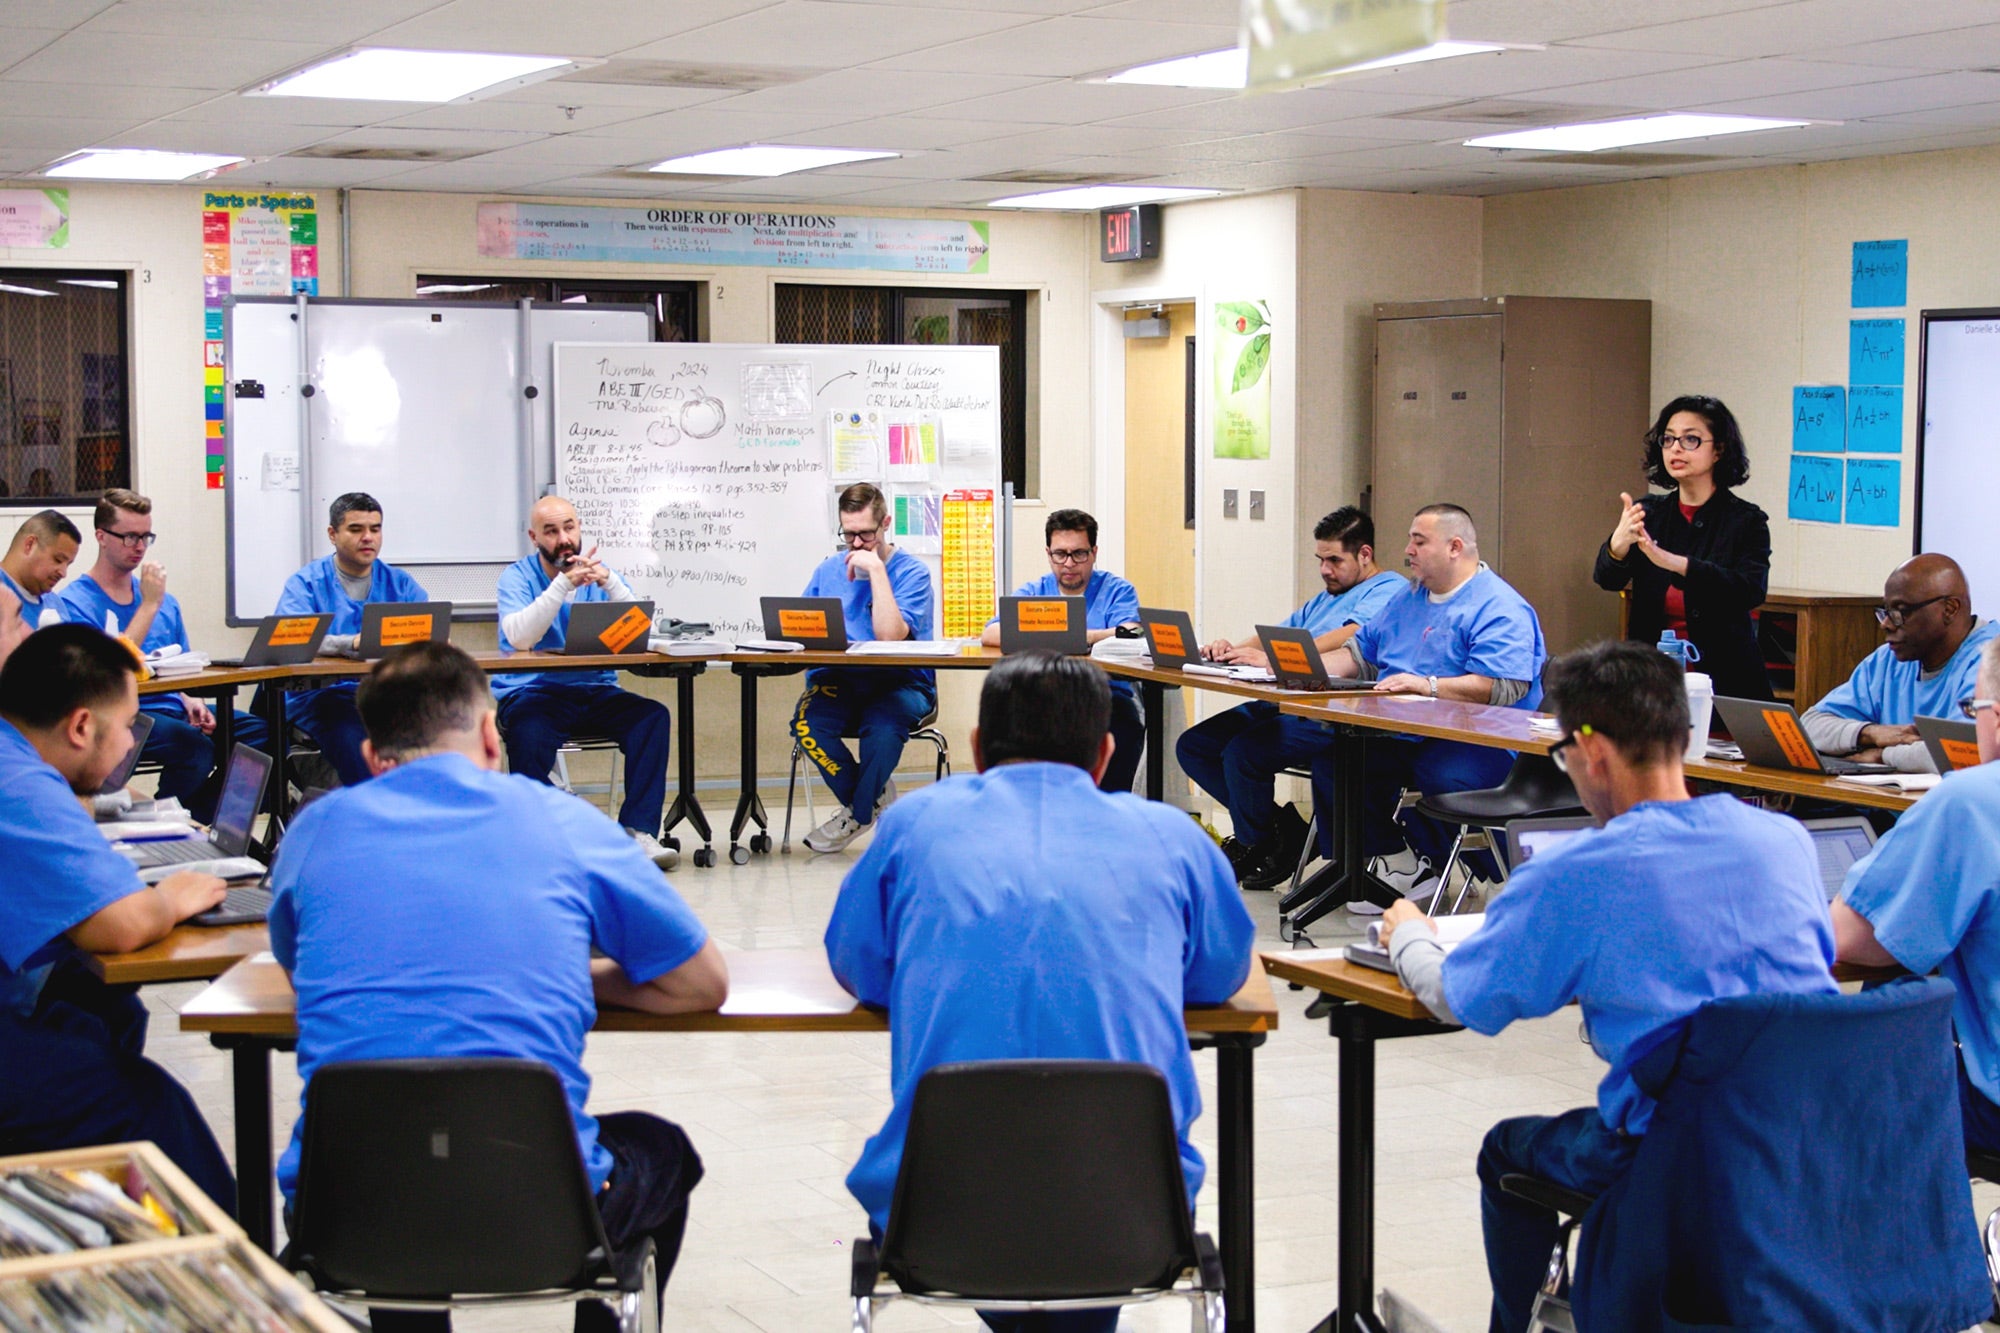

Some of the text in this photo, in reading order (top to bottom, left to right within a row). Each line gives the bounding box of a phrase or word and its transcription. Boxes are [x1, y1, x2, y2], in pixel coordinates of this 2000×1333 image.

[205, 192, 315, 212] Parts of Speech
[535, 219, 579, 229] operations
[581, 220, 590, 228] in
[647, 209, 836, 228] ORDER OF OPERATIONS
[624, 222, 733, 235] Then work with exponents.
[753, 227, 774, 236] Next,
[787, 229, 841, 239] multiplication
[1107, 211, 1132, 254] EXIT
[753, 238, 785, 246] division
[807, 239, 820, 247] left
[822, 240, 830, 248] to
[832, 241, 853, 250] right.
[143, 269, 152, 284] 3
[716, 285, 725, 300] 2
[1965, 323, 1993, 335] Danielle
[865, 358, 902, 382] Night
[598, 380, 627, 397] ABE
[735, 423, 762, 437] Math
[625, 461, 649, 481] Apply
[649, 460, 664, 474] the
[752, 459, 761, 473] to
[762, 459, 781, 473] solve
[783, 458, 824, 477] problems
[646, 565, 679, 588] Daily
